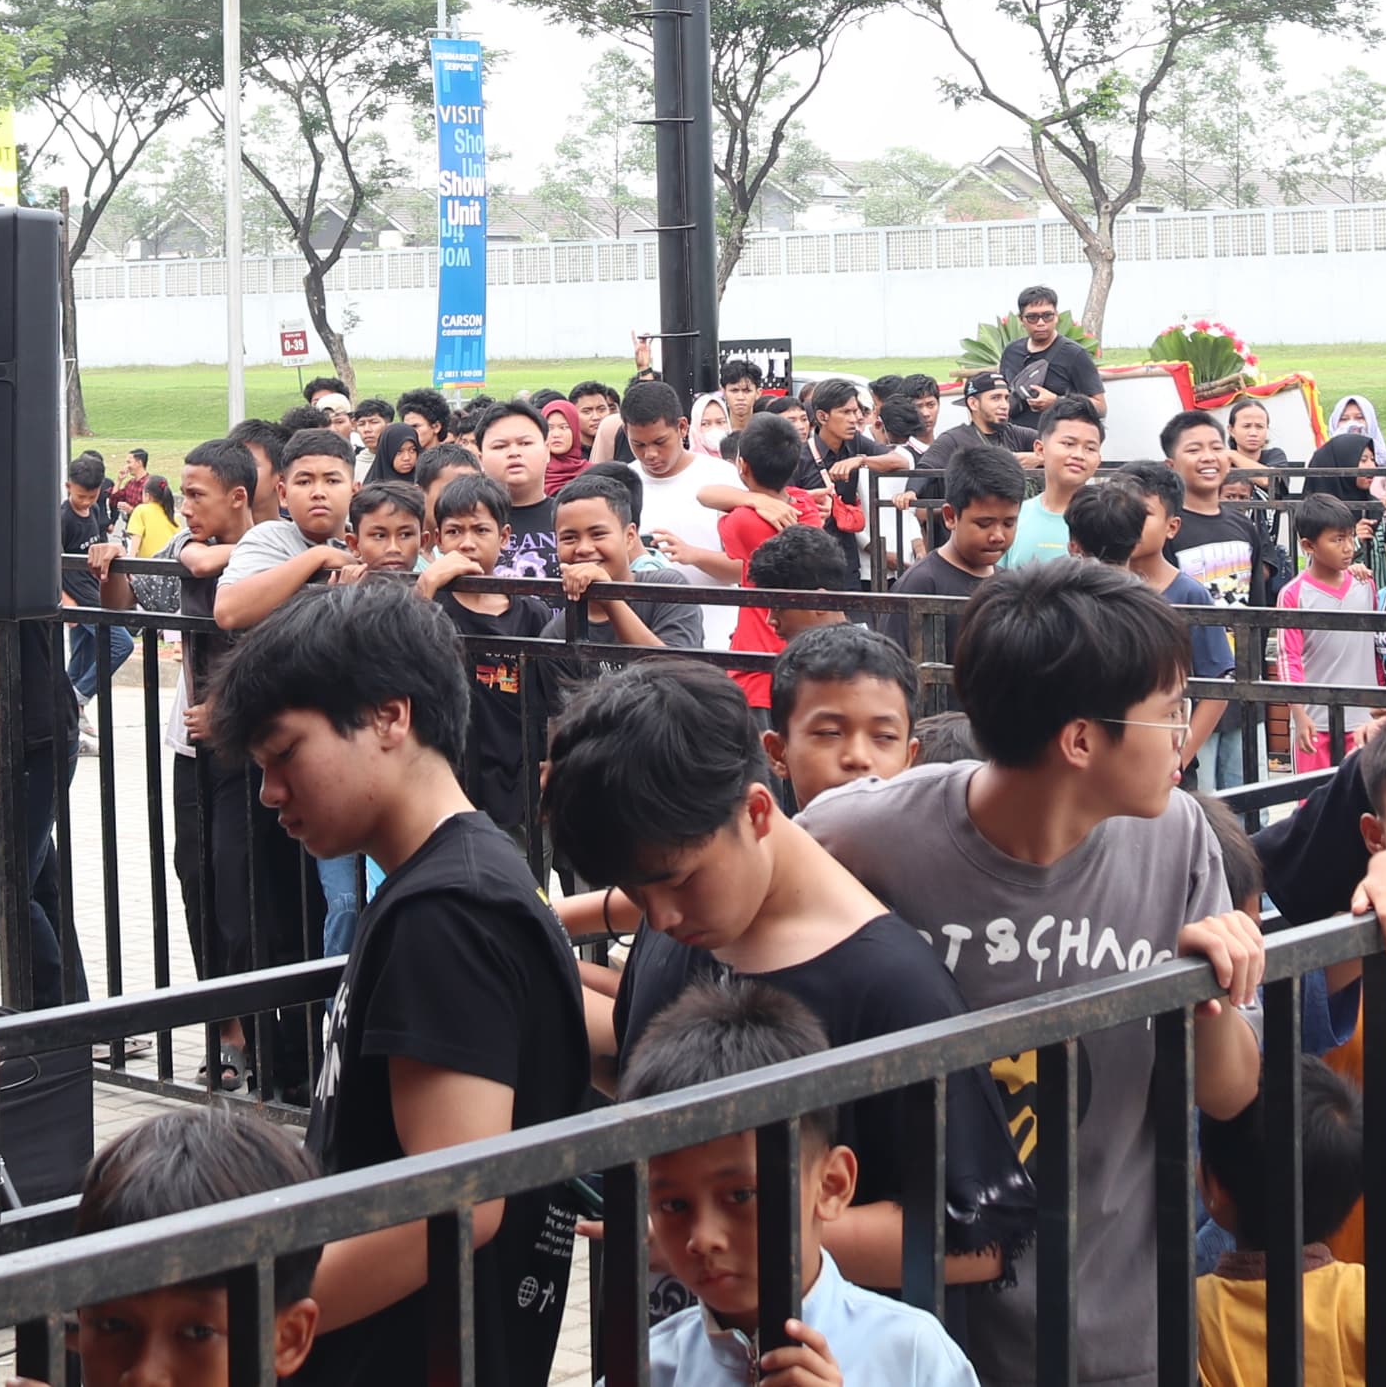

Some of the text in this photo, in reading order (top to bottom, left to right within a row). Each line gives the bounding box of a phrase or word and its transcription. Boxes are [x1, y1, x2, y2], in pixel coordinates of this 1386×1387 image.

[438, 105, 481, 124] VISIT
[439, 170, 485, 197] Show
[447, 200, 481, 226] Unit
[441, 314, 483, 327] CARSON
